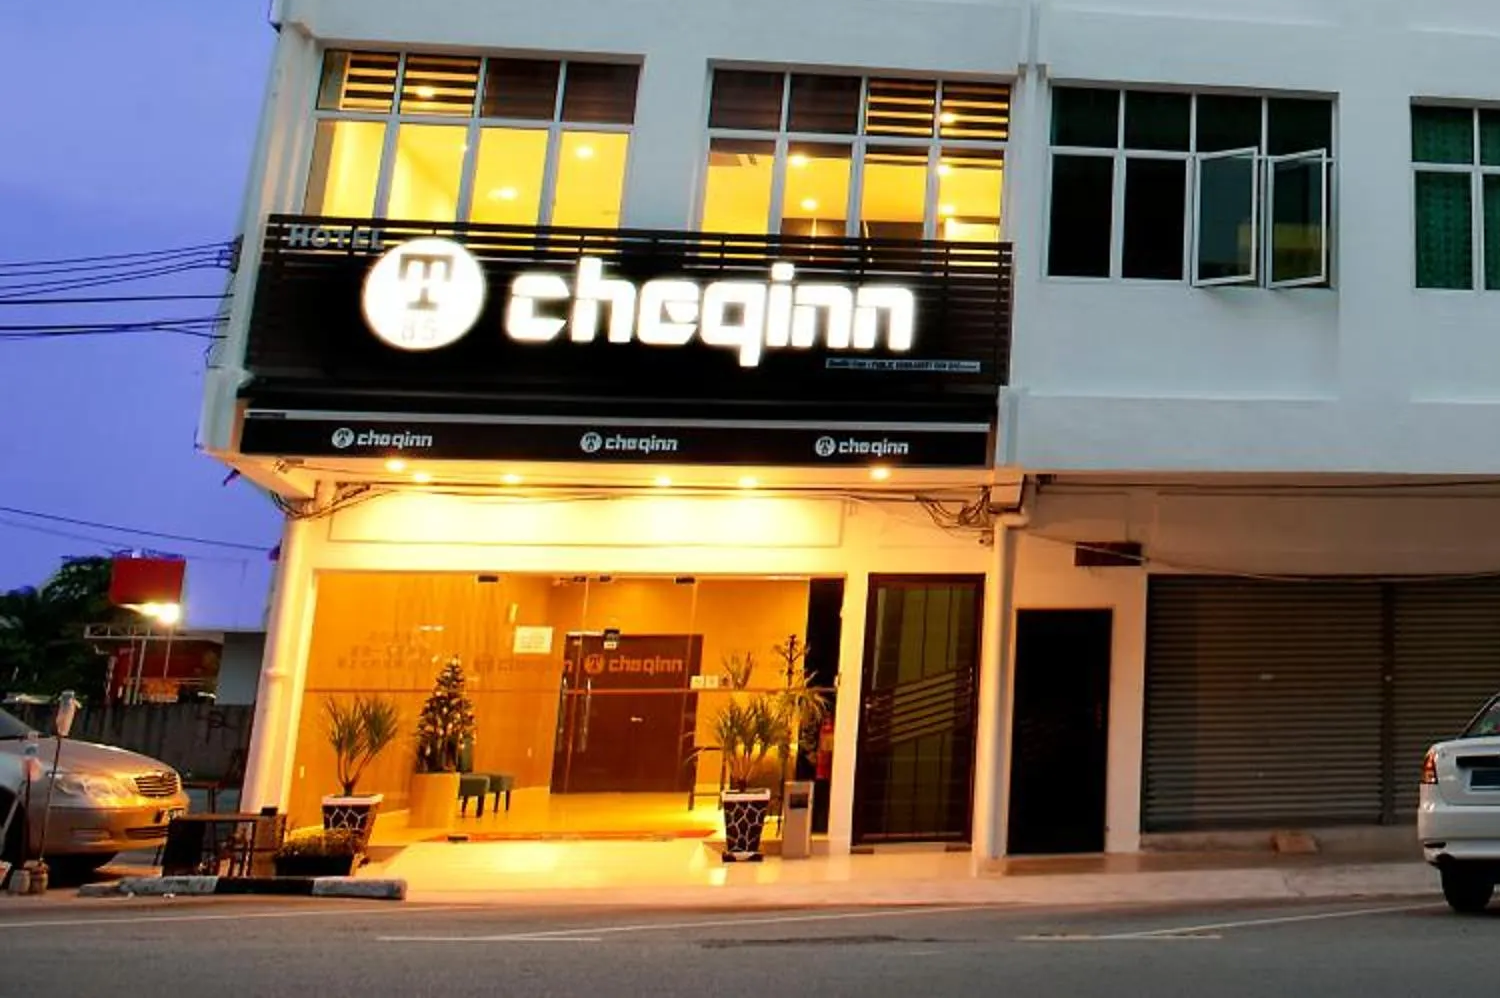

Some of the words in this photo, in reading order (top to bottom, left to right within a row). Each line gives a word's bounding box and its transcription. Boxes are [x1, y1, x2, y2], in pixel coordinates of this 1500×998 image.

[286, 223, 385, 250] HOTEL
[505, 256, 915, 367] cheqinn
[356, 429, 433, 449] cheqinn
[604, 434, 679, 454] cheqinn
[838, 438, 909, 457] cheqinn
[608, 654, 683, 675] cheqinn
